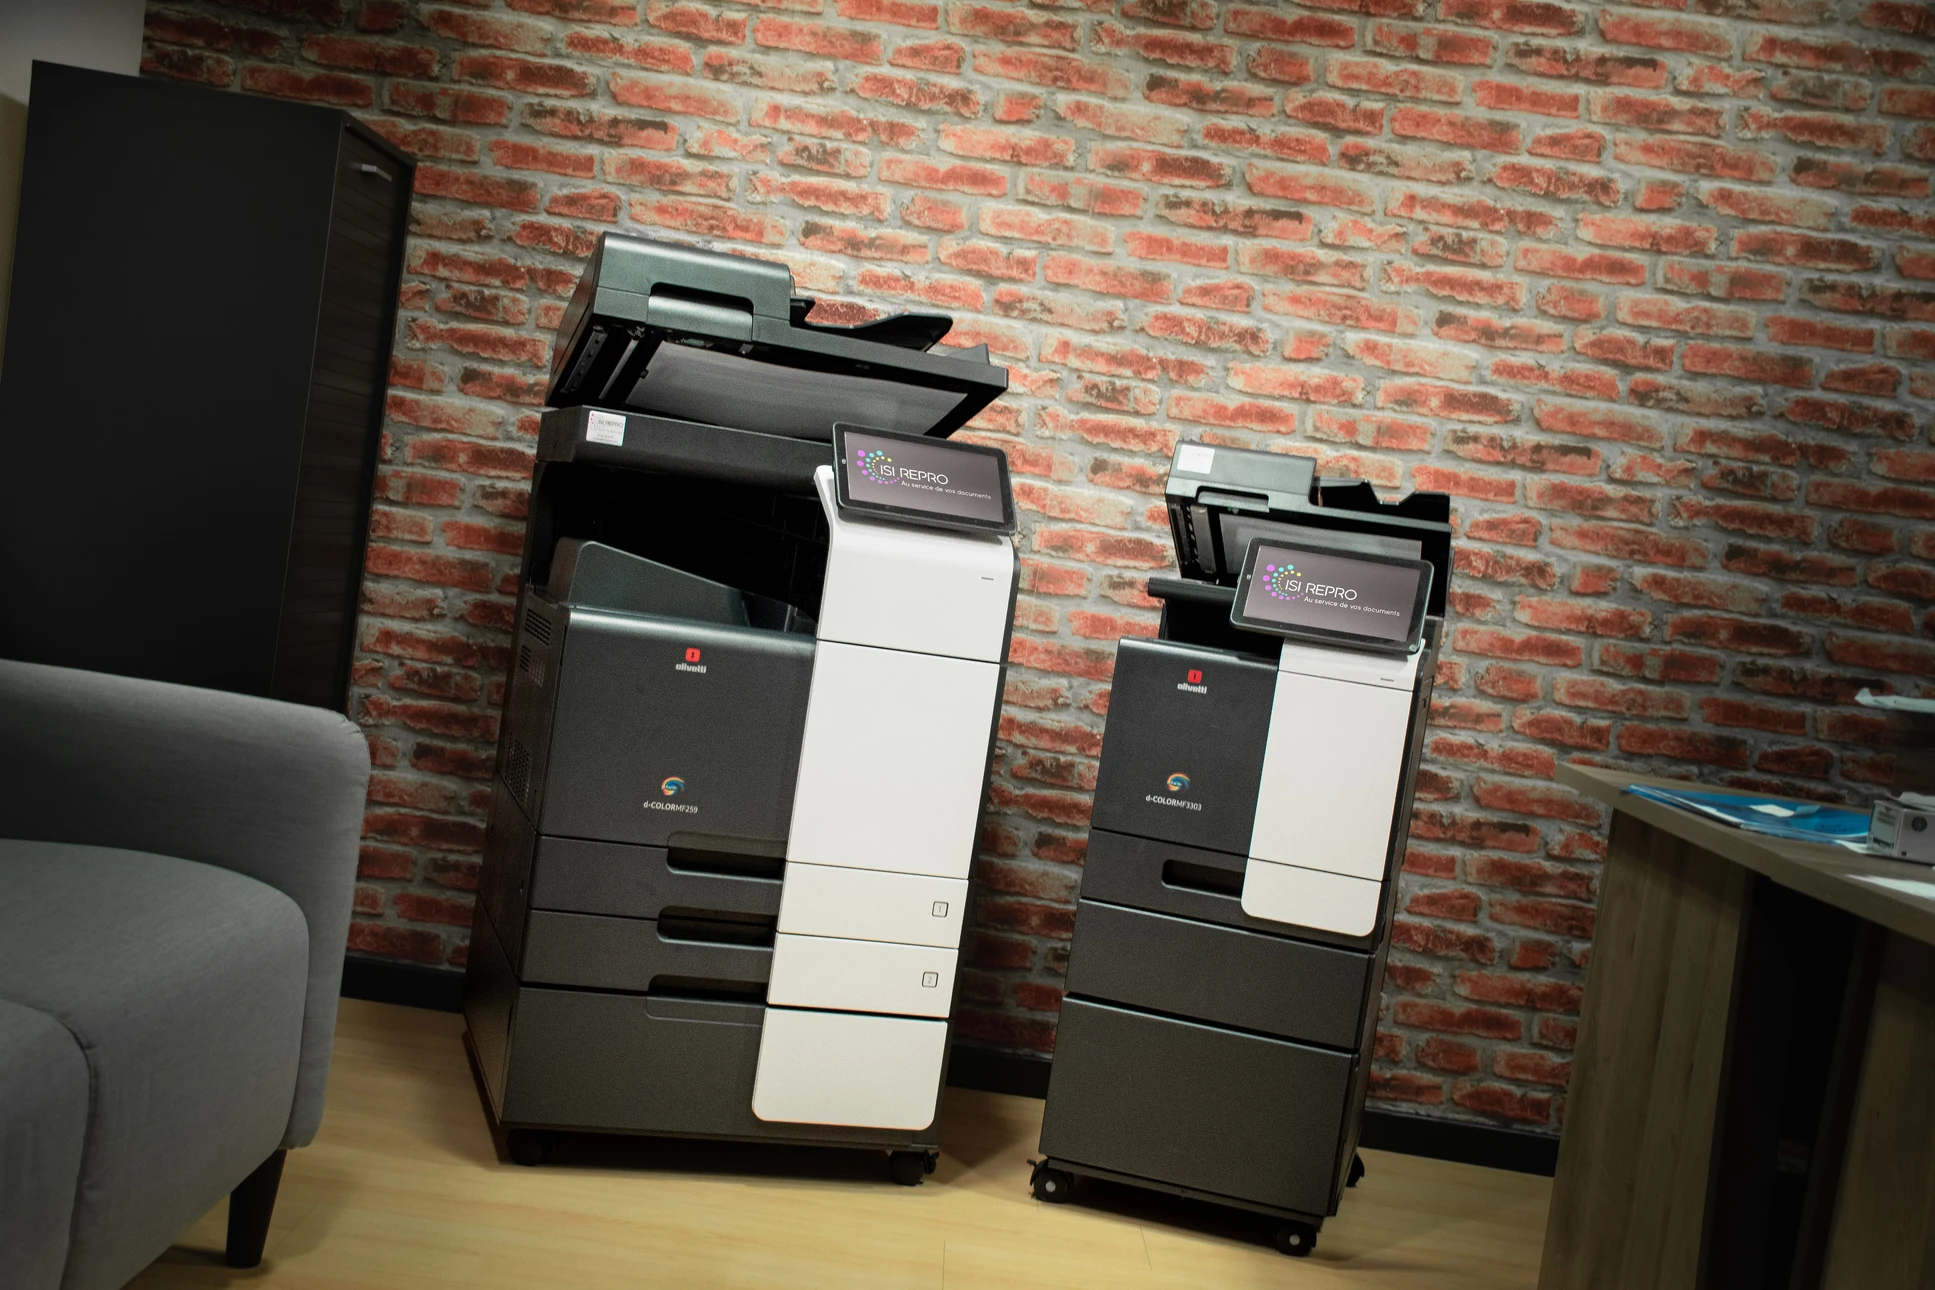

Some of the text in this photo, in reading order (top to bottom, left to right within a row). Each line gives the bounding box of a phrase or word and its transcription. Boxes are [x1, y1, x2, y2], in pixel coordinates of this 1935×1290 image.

[880, 464, 948, 484] ISI REPRO
[912, 482, 934, 491] service
[957, 488, 991, 500] documents
[1285, 580, 1357, 600] ISI REPRO
[1314, 598, 1338, 607] service
[1363, 605, 1400, 617] documents
[676, 662, 706, 673] olivetti
[1177, 682, 1207, 694] olivetti
